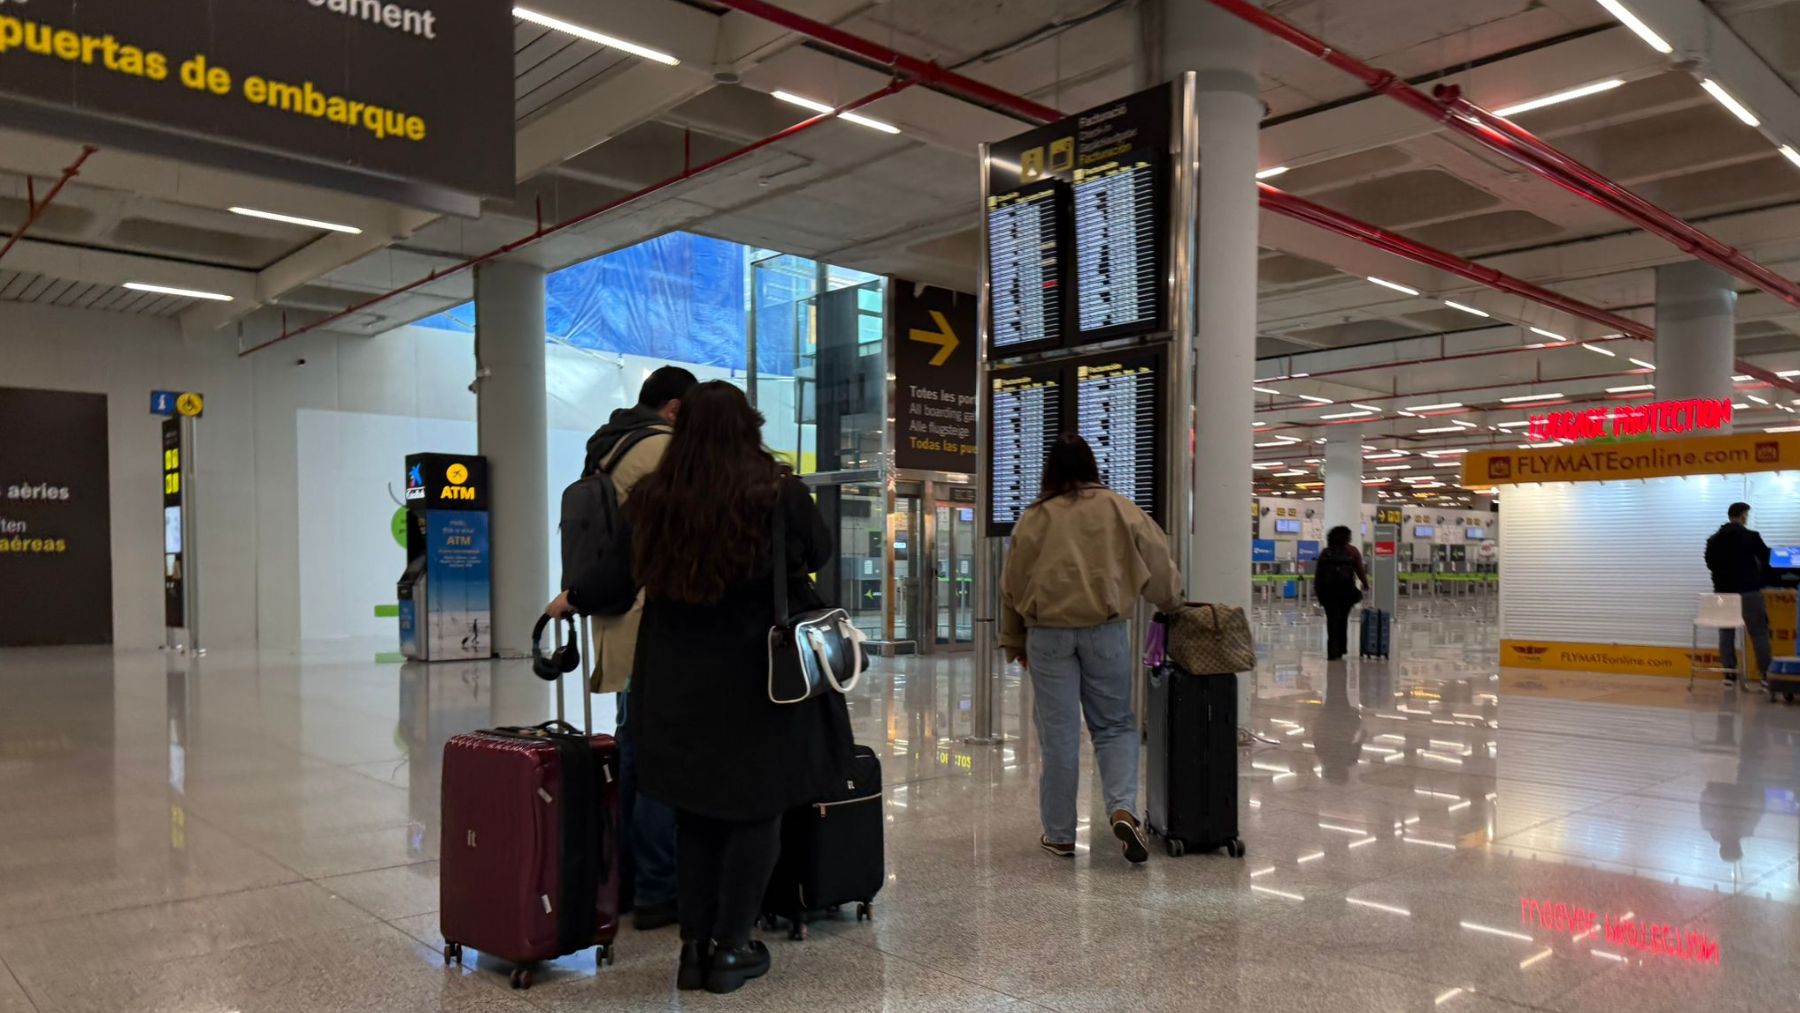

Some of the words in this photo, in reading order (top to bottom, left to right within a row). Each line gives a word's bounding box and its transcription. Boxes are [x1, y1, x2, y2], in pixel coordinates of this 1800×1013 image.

[308, 0, 436, 38] ament
[0, 14, 168, 80] puertas
[180, 55, 231, 94] de
[243, 73, 427, 140] embarque
[909, 385, 938, 400] Totes
[940, 388, 956, 402] les
[908, 402, 922, 415] All
[924, 404, 962, 422] boarding
[1613, 397, 1733, 437] PROTECTION
[908, 420, 928, 433] Alle
[908, 436, 941, 452] Todas
[943, 440, 958, 453] las
[1517, 447, 1749, 475] FLYMATEonline.com
[440, 486, 475, 500] ATM
[447, 536, 471, 545] ATM
